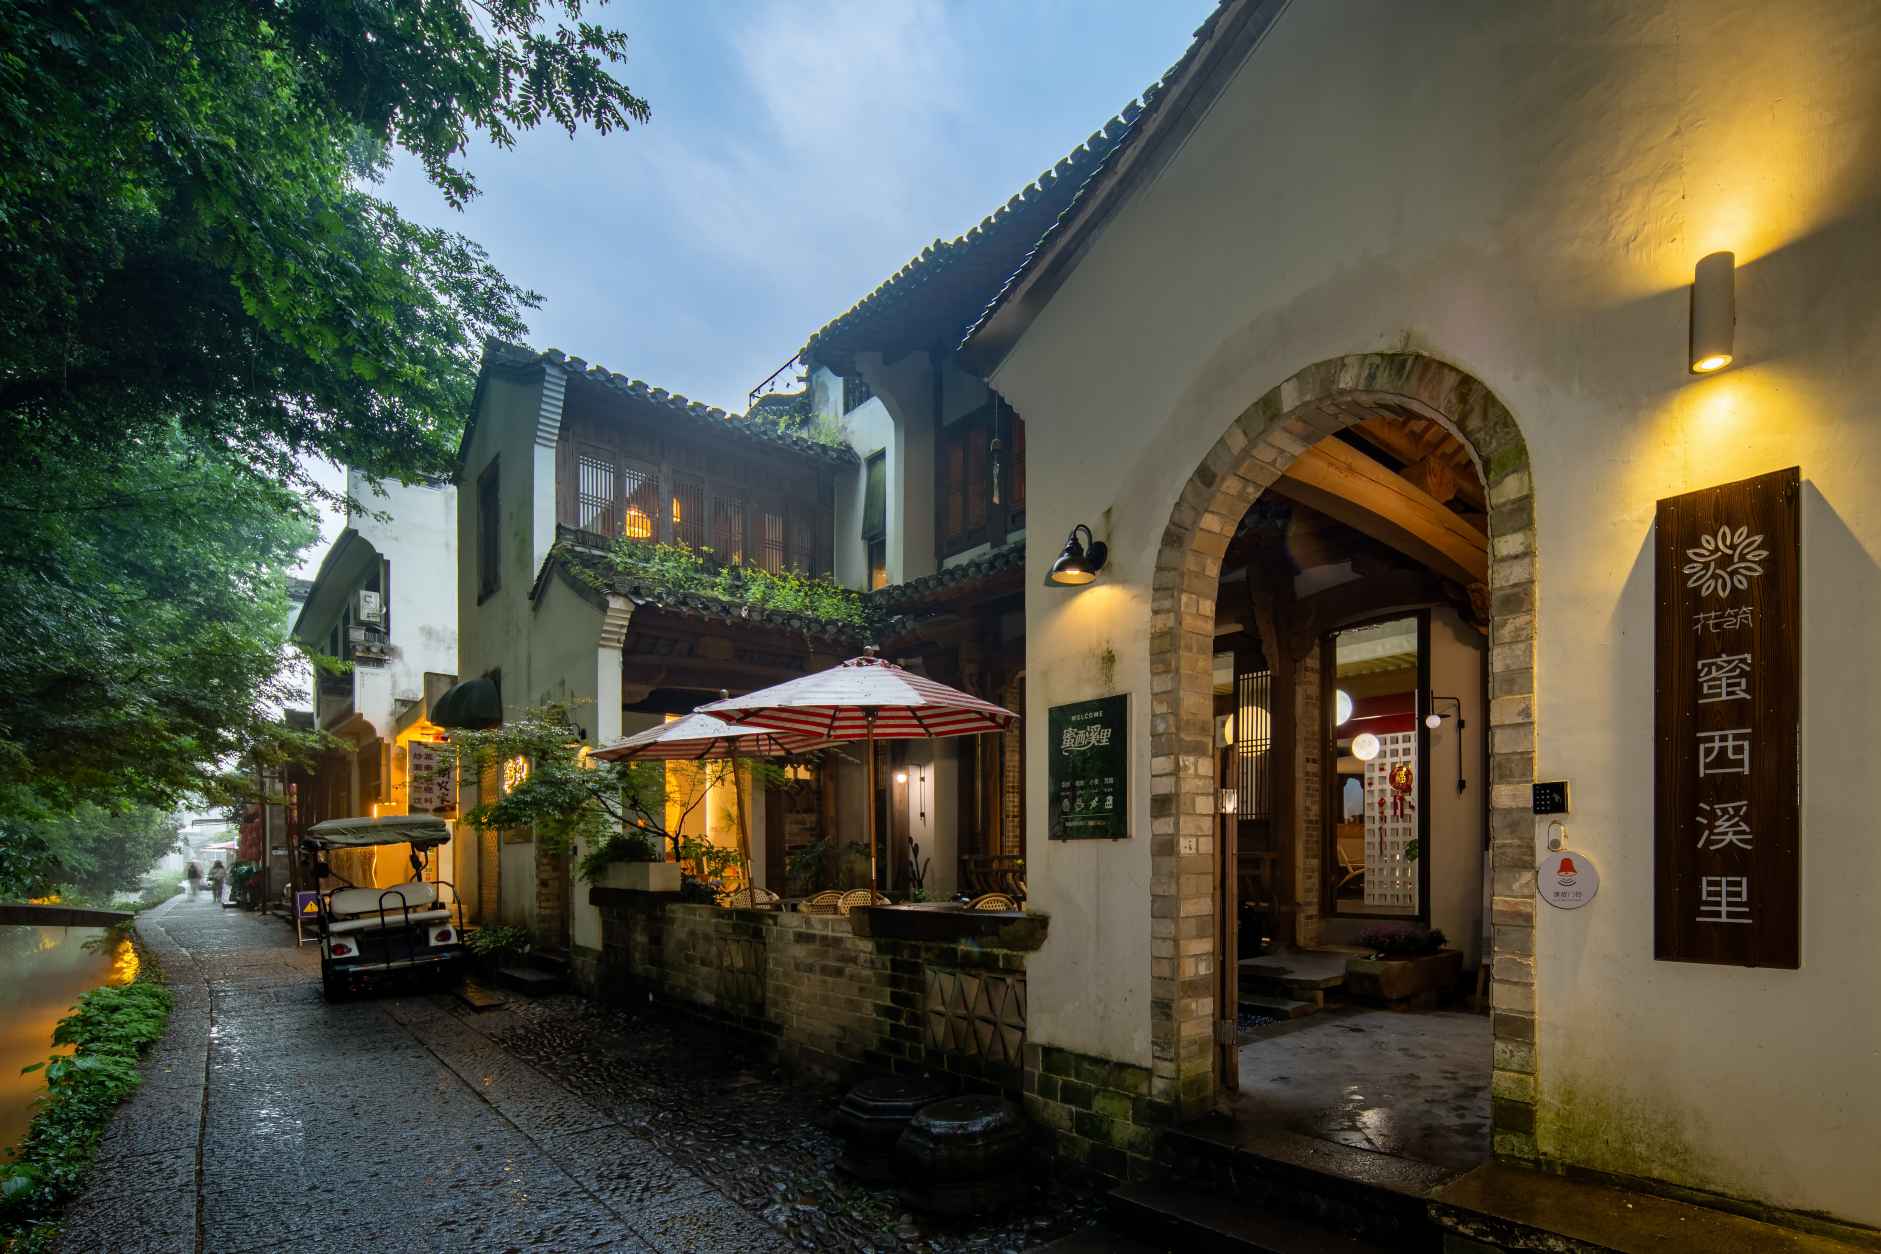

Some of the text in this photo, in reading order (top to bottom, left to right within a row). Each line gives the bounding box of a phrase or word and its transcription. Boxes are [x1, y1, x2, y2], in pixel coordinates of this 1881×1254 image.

[1691, 605, 1754, 636] 花筑
[1072, 710, 1104, 721] WELCOME
[1060, 724, 1112, 752] 蜜西溪里
[1695, 652, 1753, 924] 蜜西溪里
